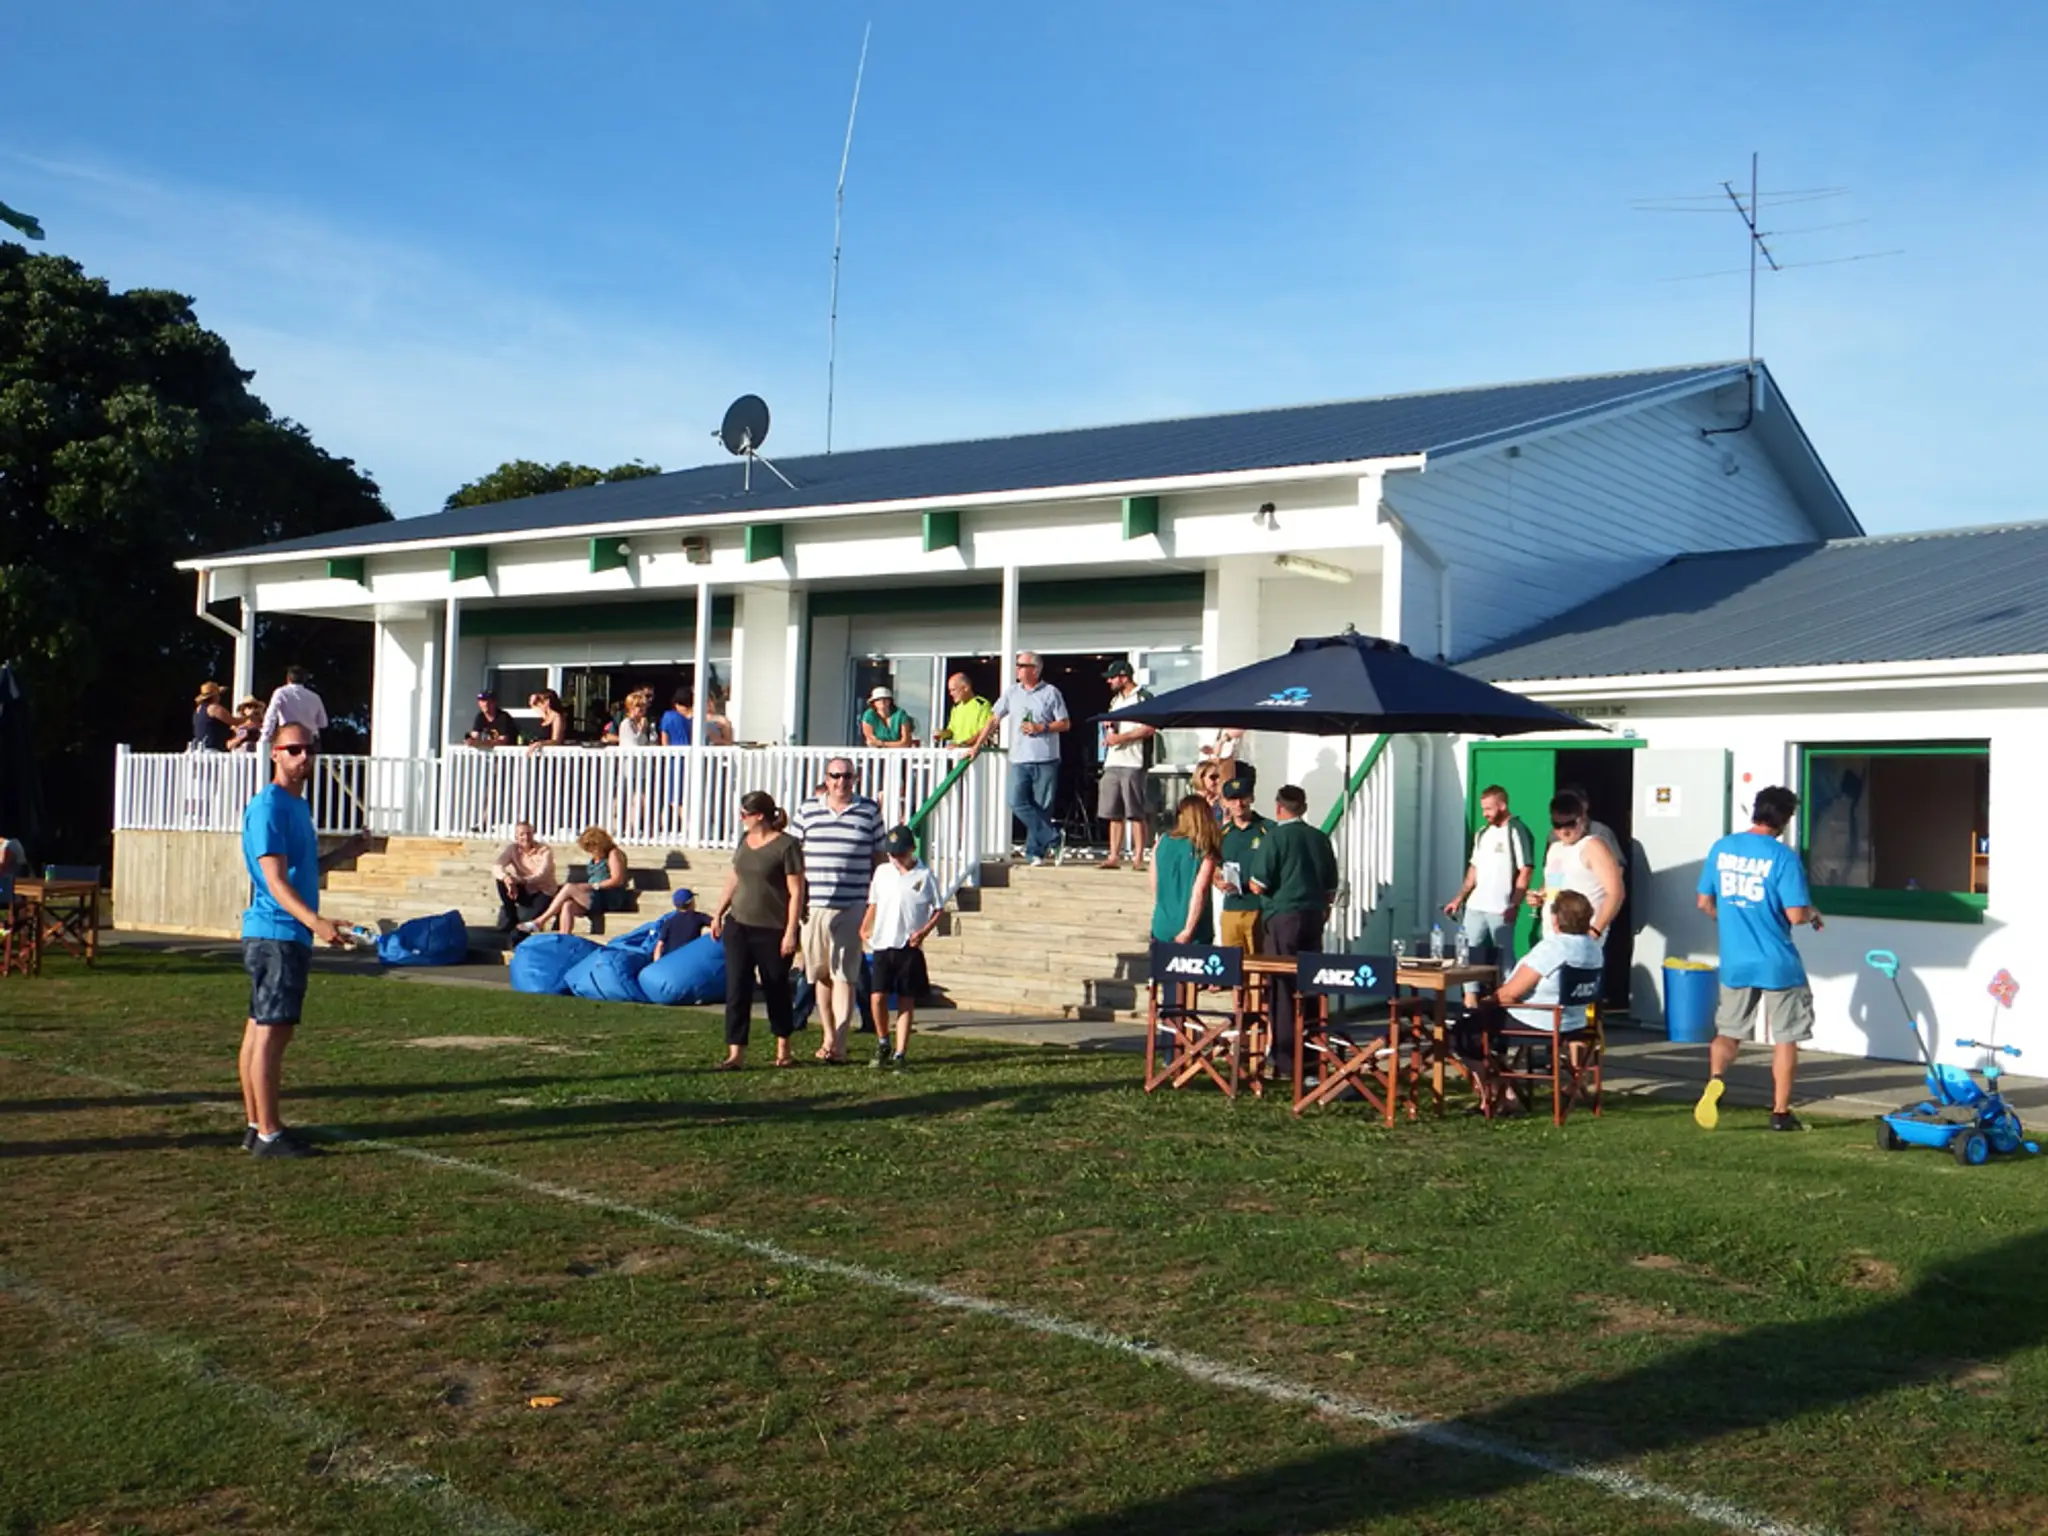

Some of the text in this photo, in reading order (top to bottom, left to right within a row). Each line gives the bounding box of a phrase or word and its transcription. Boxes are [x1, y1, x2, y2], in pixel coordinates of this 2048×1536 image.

[1255, 698, 1308, 707] ANZ
[1586, 705, 1609, 716] CLUB
[1717, 851, 1773, 877] DREAM
[1720, 871, 1765, 902] BIG
[1165, 956, 1205, 975] ANZ
[1312, 968, 1356, 986] ANZ
